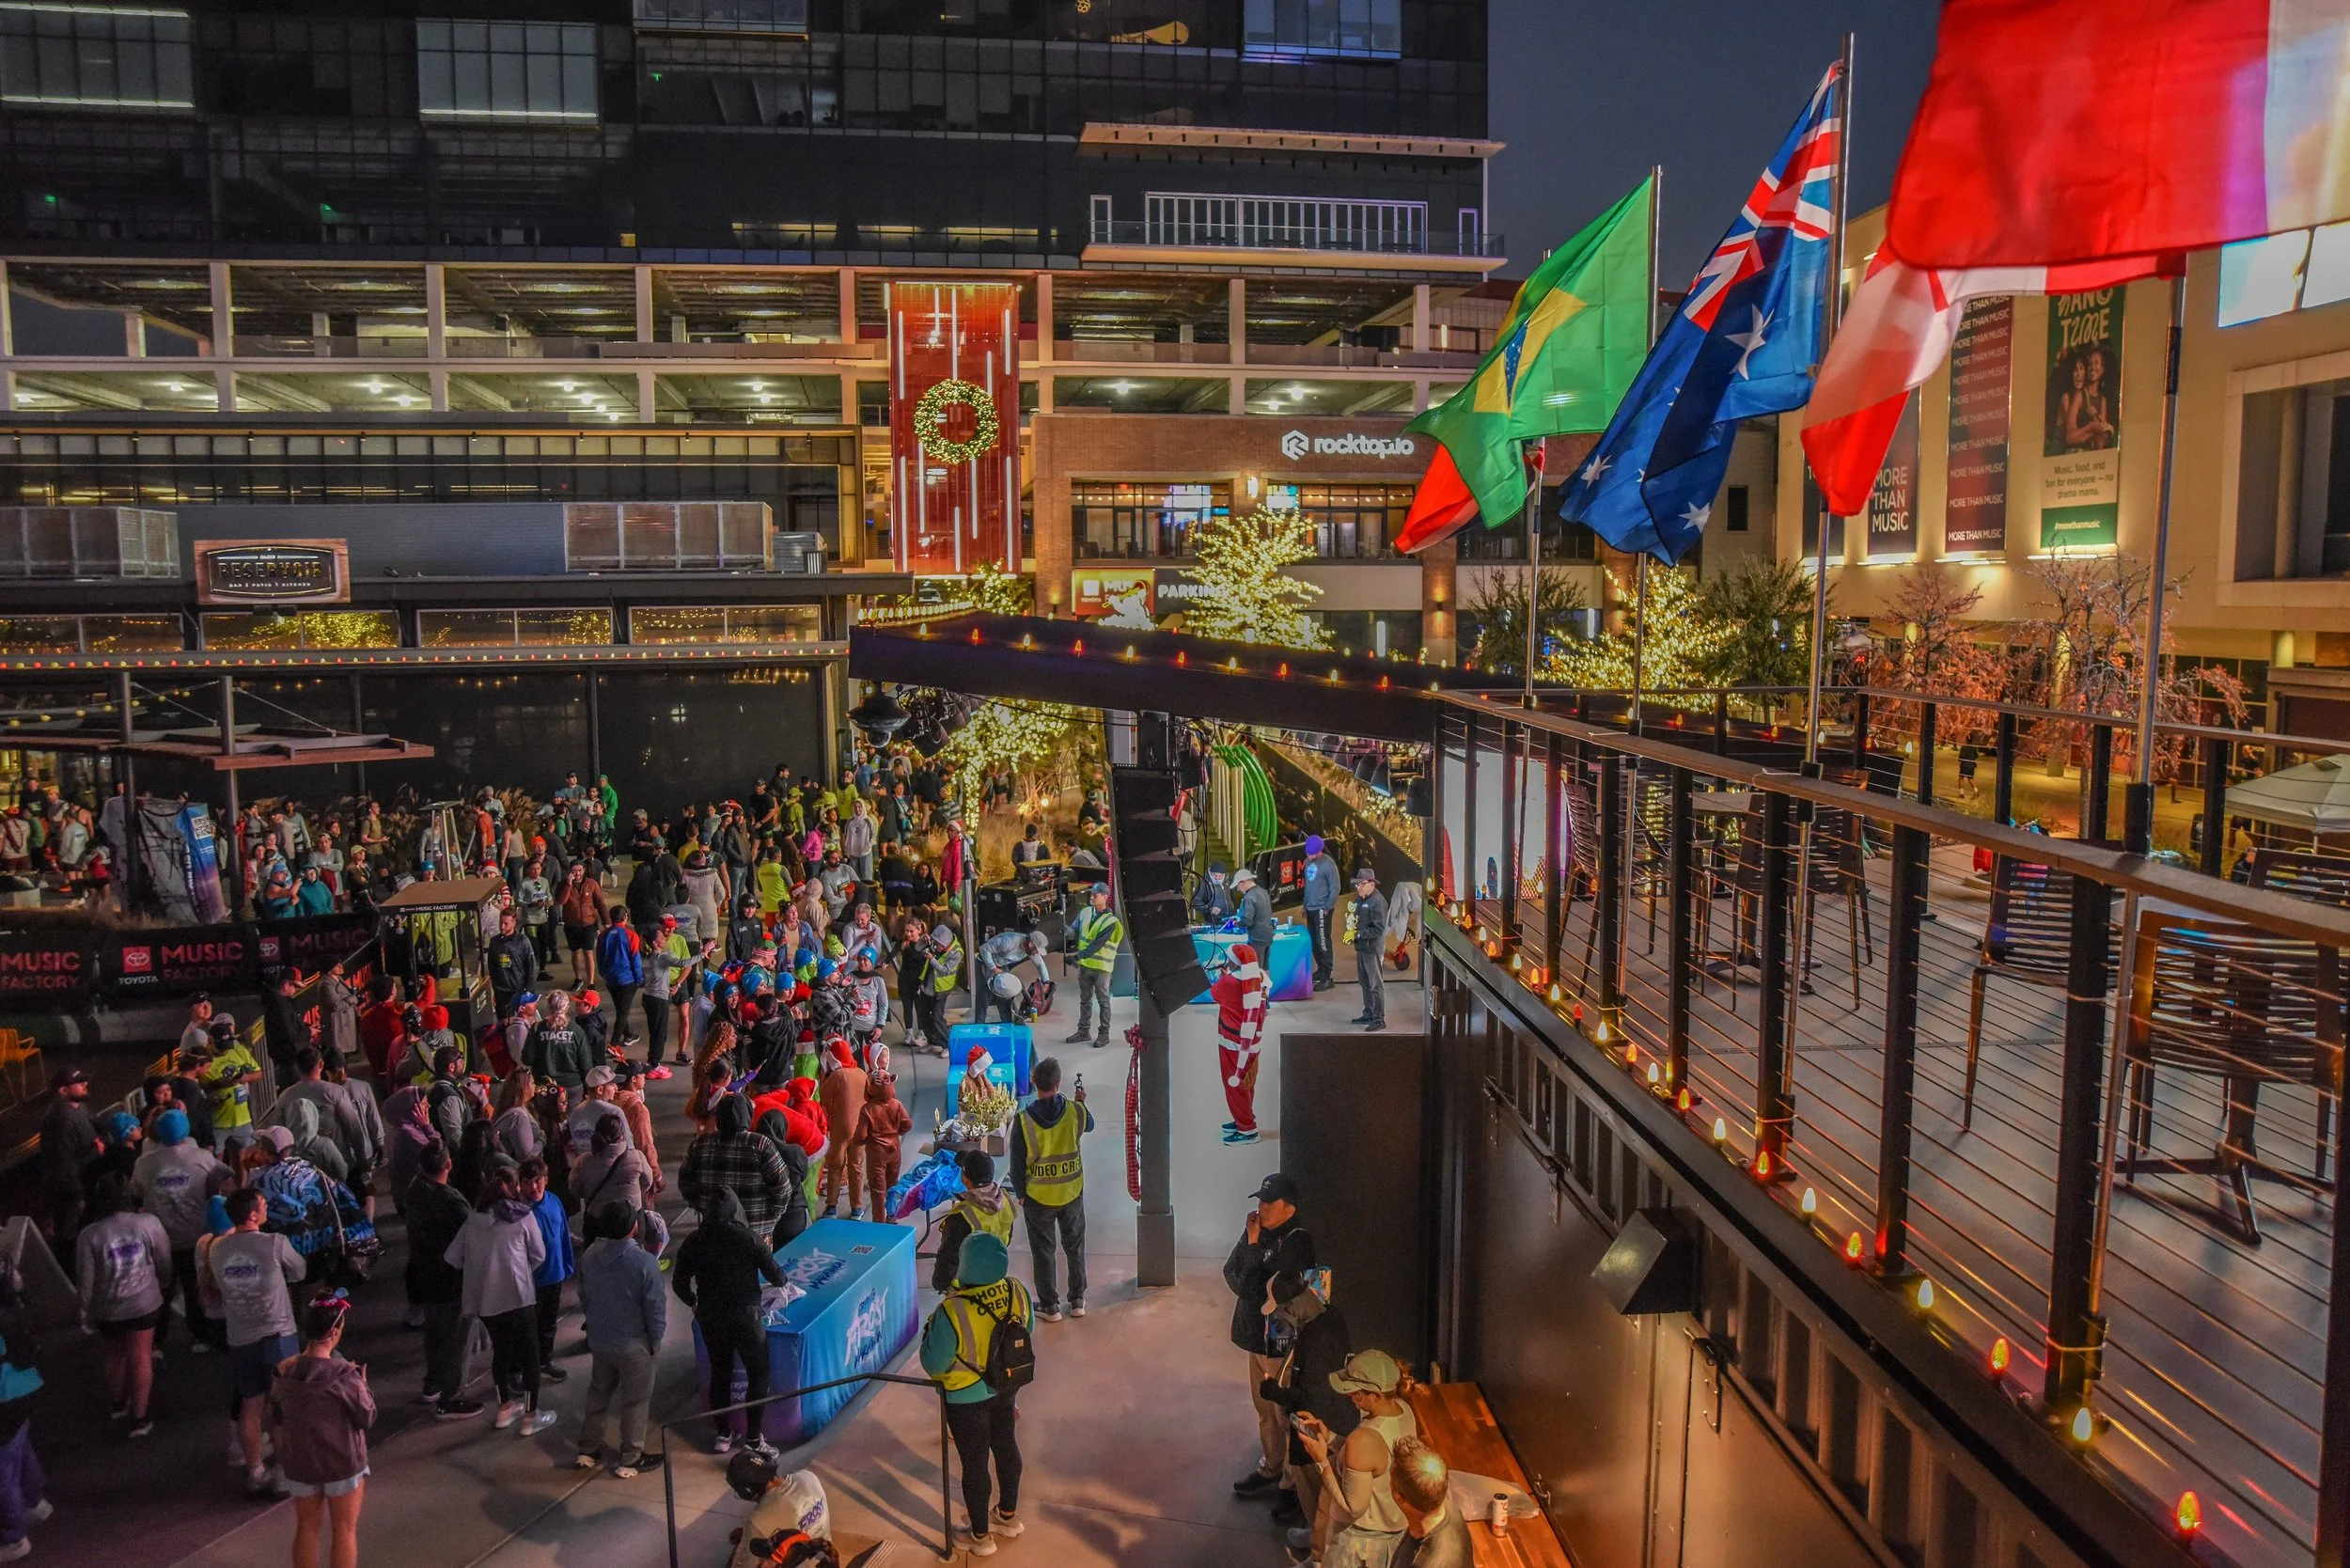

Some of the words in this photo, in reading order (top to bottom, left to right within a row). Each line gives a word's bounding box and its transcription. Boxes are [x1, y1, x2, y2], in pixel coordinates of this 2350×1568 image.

[1972, 299, 1989, 310] THAN
[1959, 320, 1971, 332] ORE
[1972, 314, 1989, 327] THAN
[1989, 308, 2010, 323] MUSIC
[2060, 308, 2110, 348] TIME
[1953, 337, 1970, 350] MORE
[1972, 333, 1989, 345] THAN
[1988, 326, 2009, 339] MUSIC
[1953, 355, 1970, 368] MORE
[1971, 352, 1989, 363] THAN
[1988, 345, 2008, 358] MUSIC
[1952, 376, 1970, 386] MORE
[1970, 370, 1988, 382] THAN
[1987, 365, 2008, 376] MUSIC
[1951, 395, 1969, 406] MORE
[1970, 390, 1987, 402] THAN
[1987, 385, 2008, 398] MUSIC
[1951, 416, 1968, 427] MORE
[1970, 412, 1985, 423] THAN
[1985, 408, 2006, 419] MUSIC
[1950, 441, 1968, 451] MORE
[1968, 438, 1985, 449] THAN
[1985, 434, 2006, 446] MUSIC
[1950, 468, 1966, 478] MORE
[1968, 466, 1984, 477] THAN
[1985, 463, 2005, 474] MUSIC
[2053, 465, 2074, 474] Music,
[2076, 463, 2091, 472] food,
[2092, 461, 2106, 470] and
[1873, 466, 1907, 487] MORE
[2045, 478, 2055, 487] fun
[2057, 478, 2065, 487] for
[2066, 476, 2096, 485] everyone
[1873, 489, 1905, 510] THAN
[1950, 498, 1966, 509] MORE
[1966, 496, 1983, 506] THAN
[1983, 494, 2004, 504] MUSIC
[2057, 490, 2077, 499] drama
[1872, 511, 1908, 532] MUSIC
[1948, 530, 1966, 541] MORE
[1966, 530, 1982, 541] THAN
[1982, 528, 2002, 540] MUSIC
[217, 562, 321, 579] RESERVOIR
[1278, 884, 1295, 893] TOYOTA
[290, 929, 368, 954] MUSIC
[1, 951, 81, 972] MUSIC
[161, 942, 243, 964] MUSIC
[118, 975, 158, 985] TOYOTA
[162, 964, 241, 980] FACTORY
[0, 975, 81, 989] FACTORY
[540, 1030, 573, 1042] STACEY
[1030, 1164, 1057, 1177] VIDEO
[798, 1497, 823, 1531] FROST
